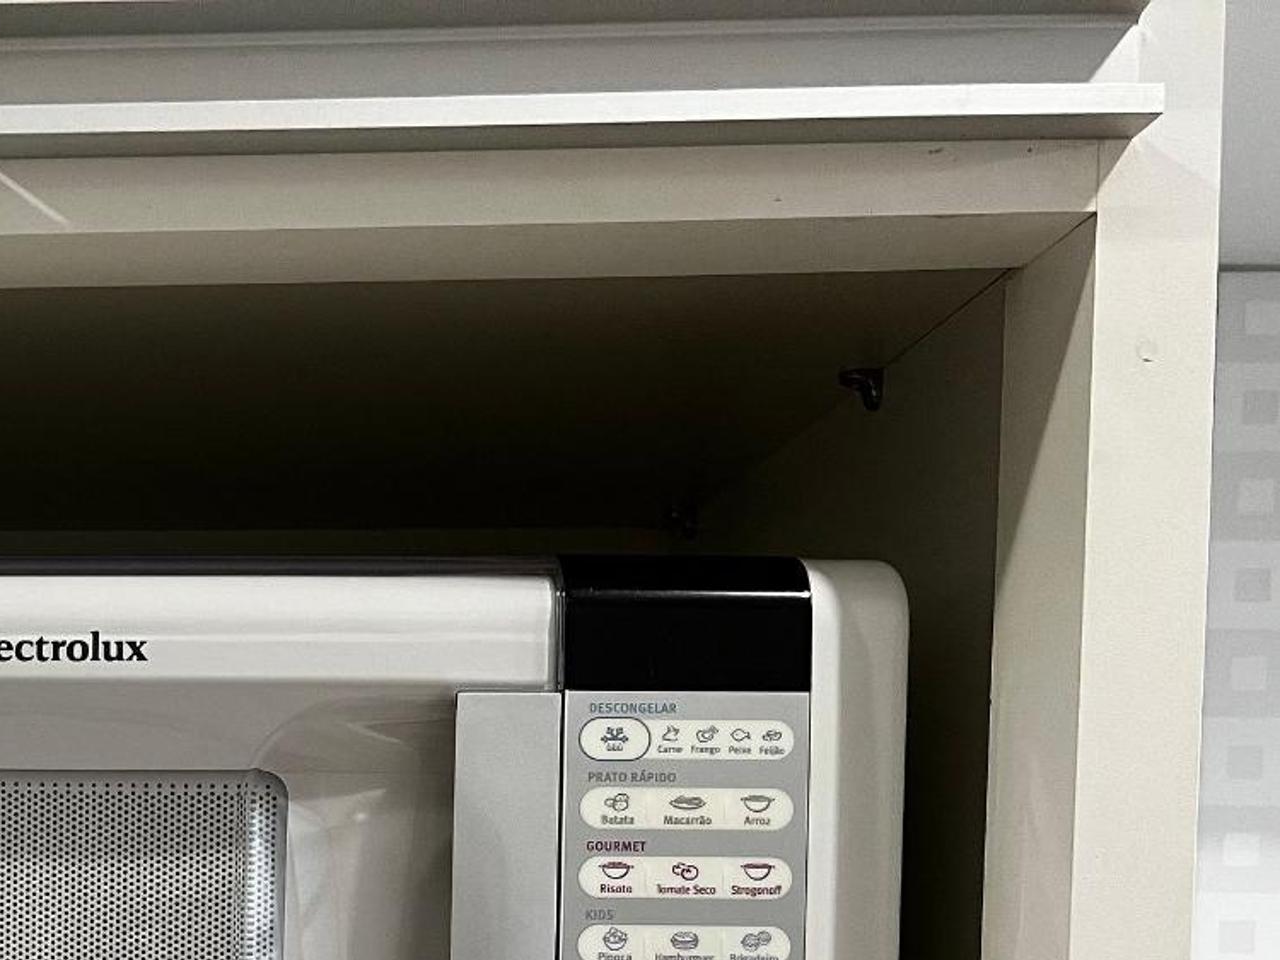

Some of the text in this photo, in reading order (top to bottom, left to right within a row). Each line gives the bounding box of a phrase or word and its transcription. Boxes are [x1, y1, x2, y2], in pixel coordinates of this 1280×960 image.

[589, 703, 677, 714] DESCONGELAR
[657, 745, 683, 754] Carne
[690, 745, 721, 755] Frango
[728, 745, 752, 754] Peixe
[759, 746, 785, 756] Feijão
[587, 769, 677, 783] PRATO RÁPIDO
[601, 815, 634, 825] Batata
[663, 814, 712, 826] Macarrão
[744, 815, 770, 826] Arroz
[586, 841, 646, 852] GOURMET
[600, 883, 633, 894] Risoto
[656, 884, 716, 896] Tomate Seco
[731, 885, 782, 897] Strogonoff
[585, 909, 615, 921] KIDS
